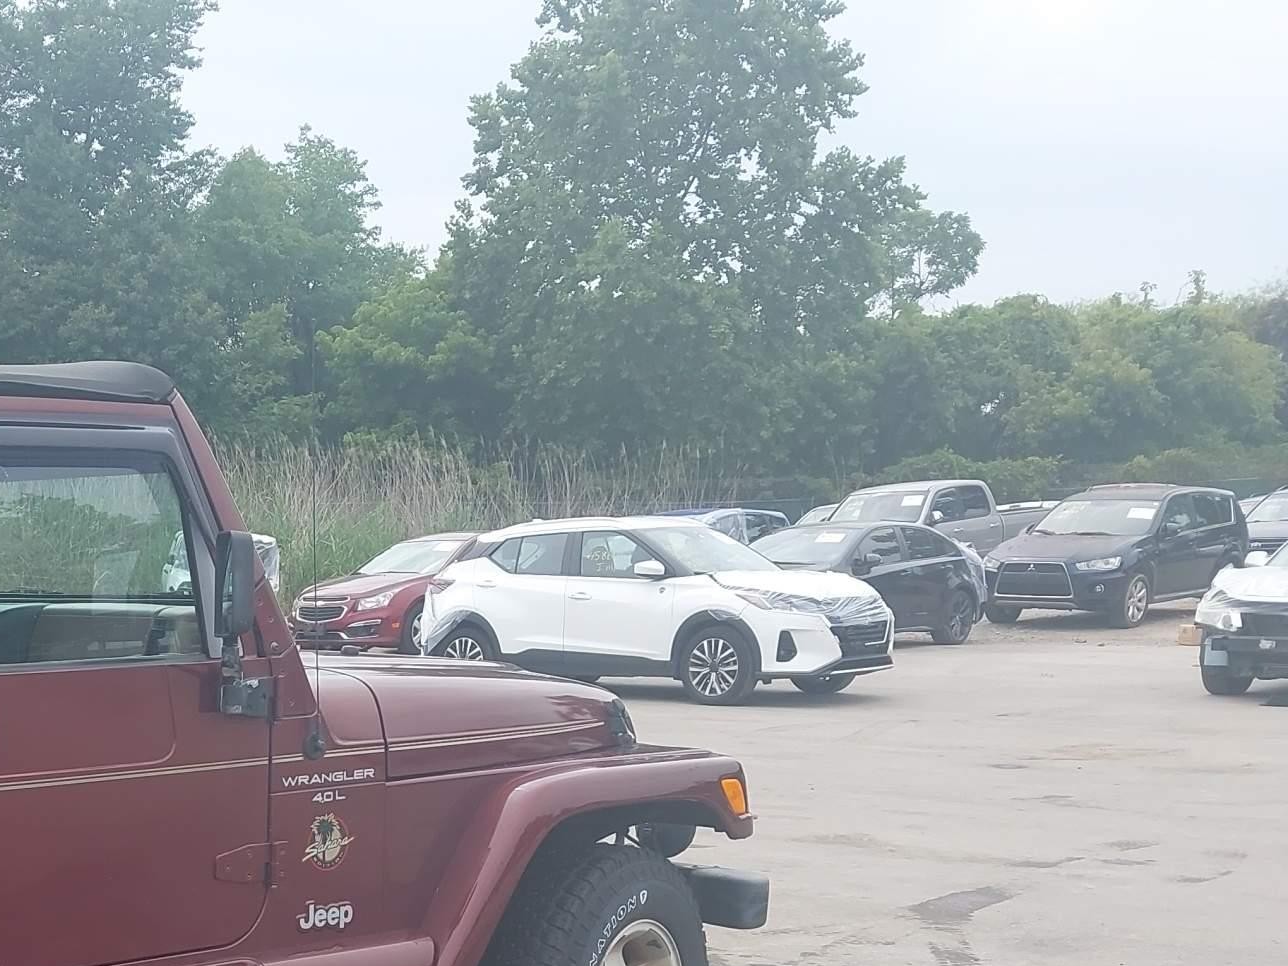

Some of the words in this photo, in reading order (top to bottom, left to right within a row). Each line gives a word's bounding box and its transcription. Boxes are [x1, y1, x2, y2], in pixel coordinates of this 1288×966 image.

[281, 767, 376, 788] WRANGLER
[301, 834, 355, 863] Sahara
[296, 900, 354, 930] Jeep
